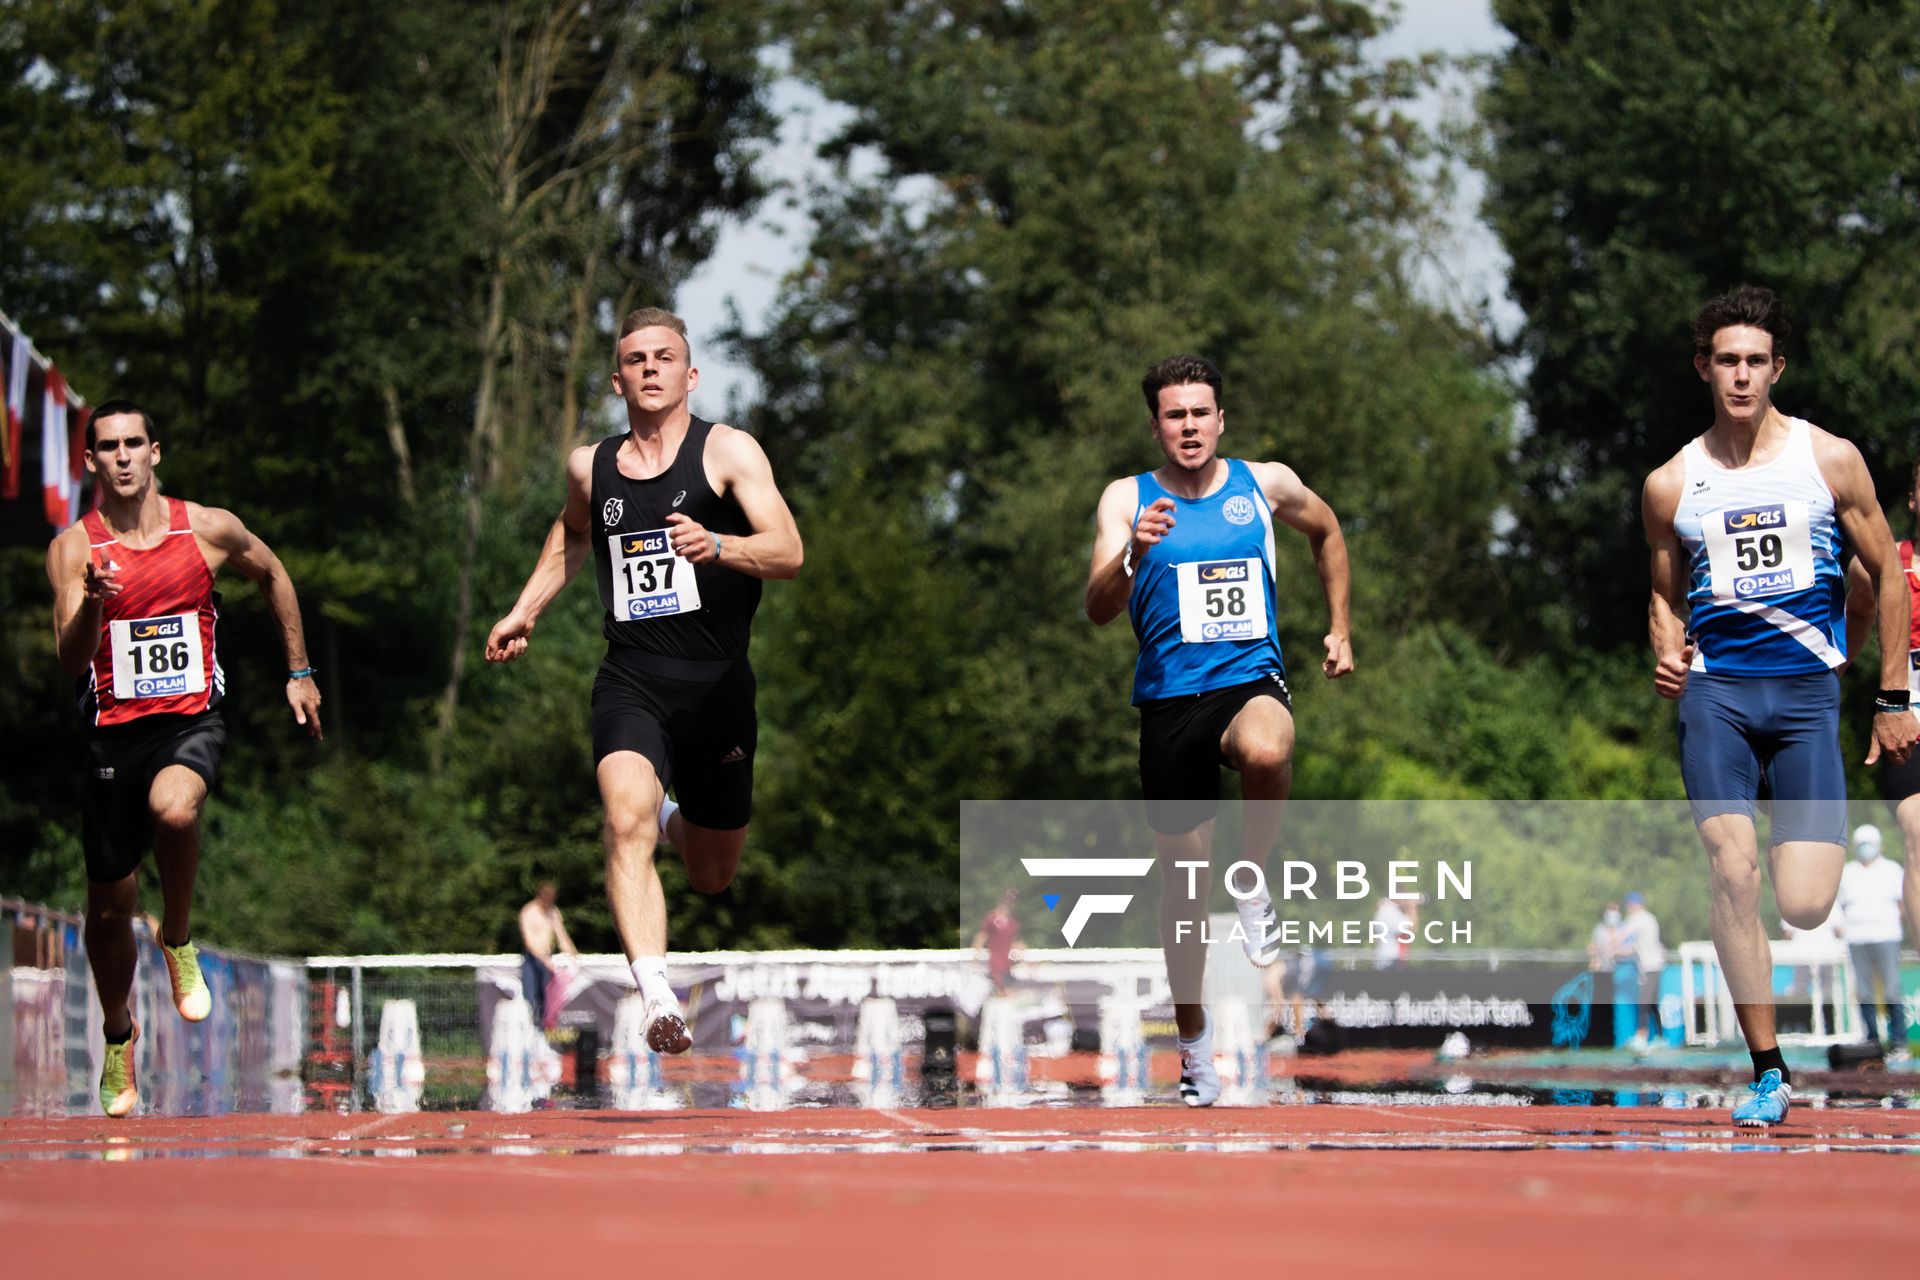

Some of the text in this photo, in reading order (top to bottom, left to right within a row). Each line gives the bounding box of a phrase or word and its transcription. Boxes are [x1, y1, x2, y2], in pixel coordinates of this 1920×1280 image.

[603, 498, 623, 527] 96
[1757, 510, 1781, 525] GLS
[644, 537, 663, 551] GLS
[1735, 534, 1783, 571] 59
[622, 557, 675, 594] 137
[1226, 566, 1246, 579] GLS
[1758, 573, 1791, 587] PLAN
[647, 596, 678, 609] PLAN
[1206, 587, 1246, 617] 58
[158, 622, 180, 635] GLS
[1222, 621, 1252, 633] PLAN
[128, 641, 189, 675] 186
[156, 677, 185, 689] PLAN
